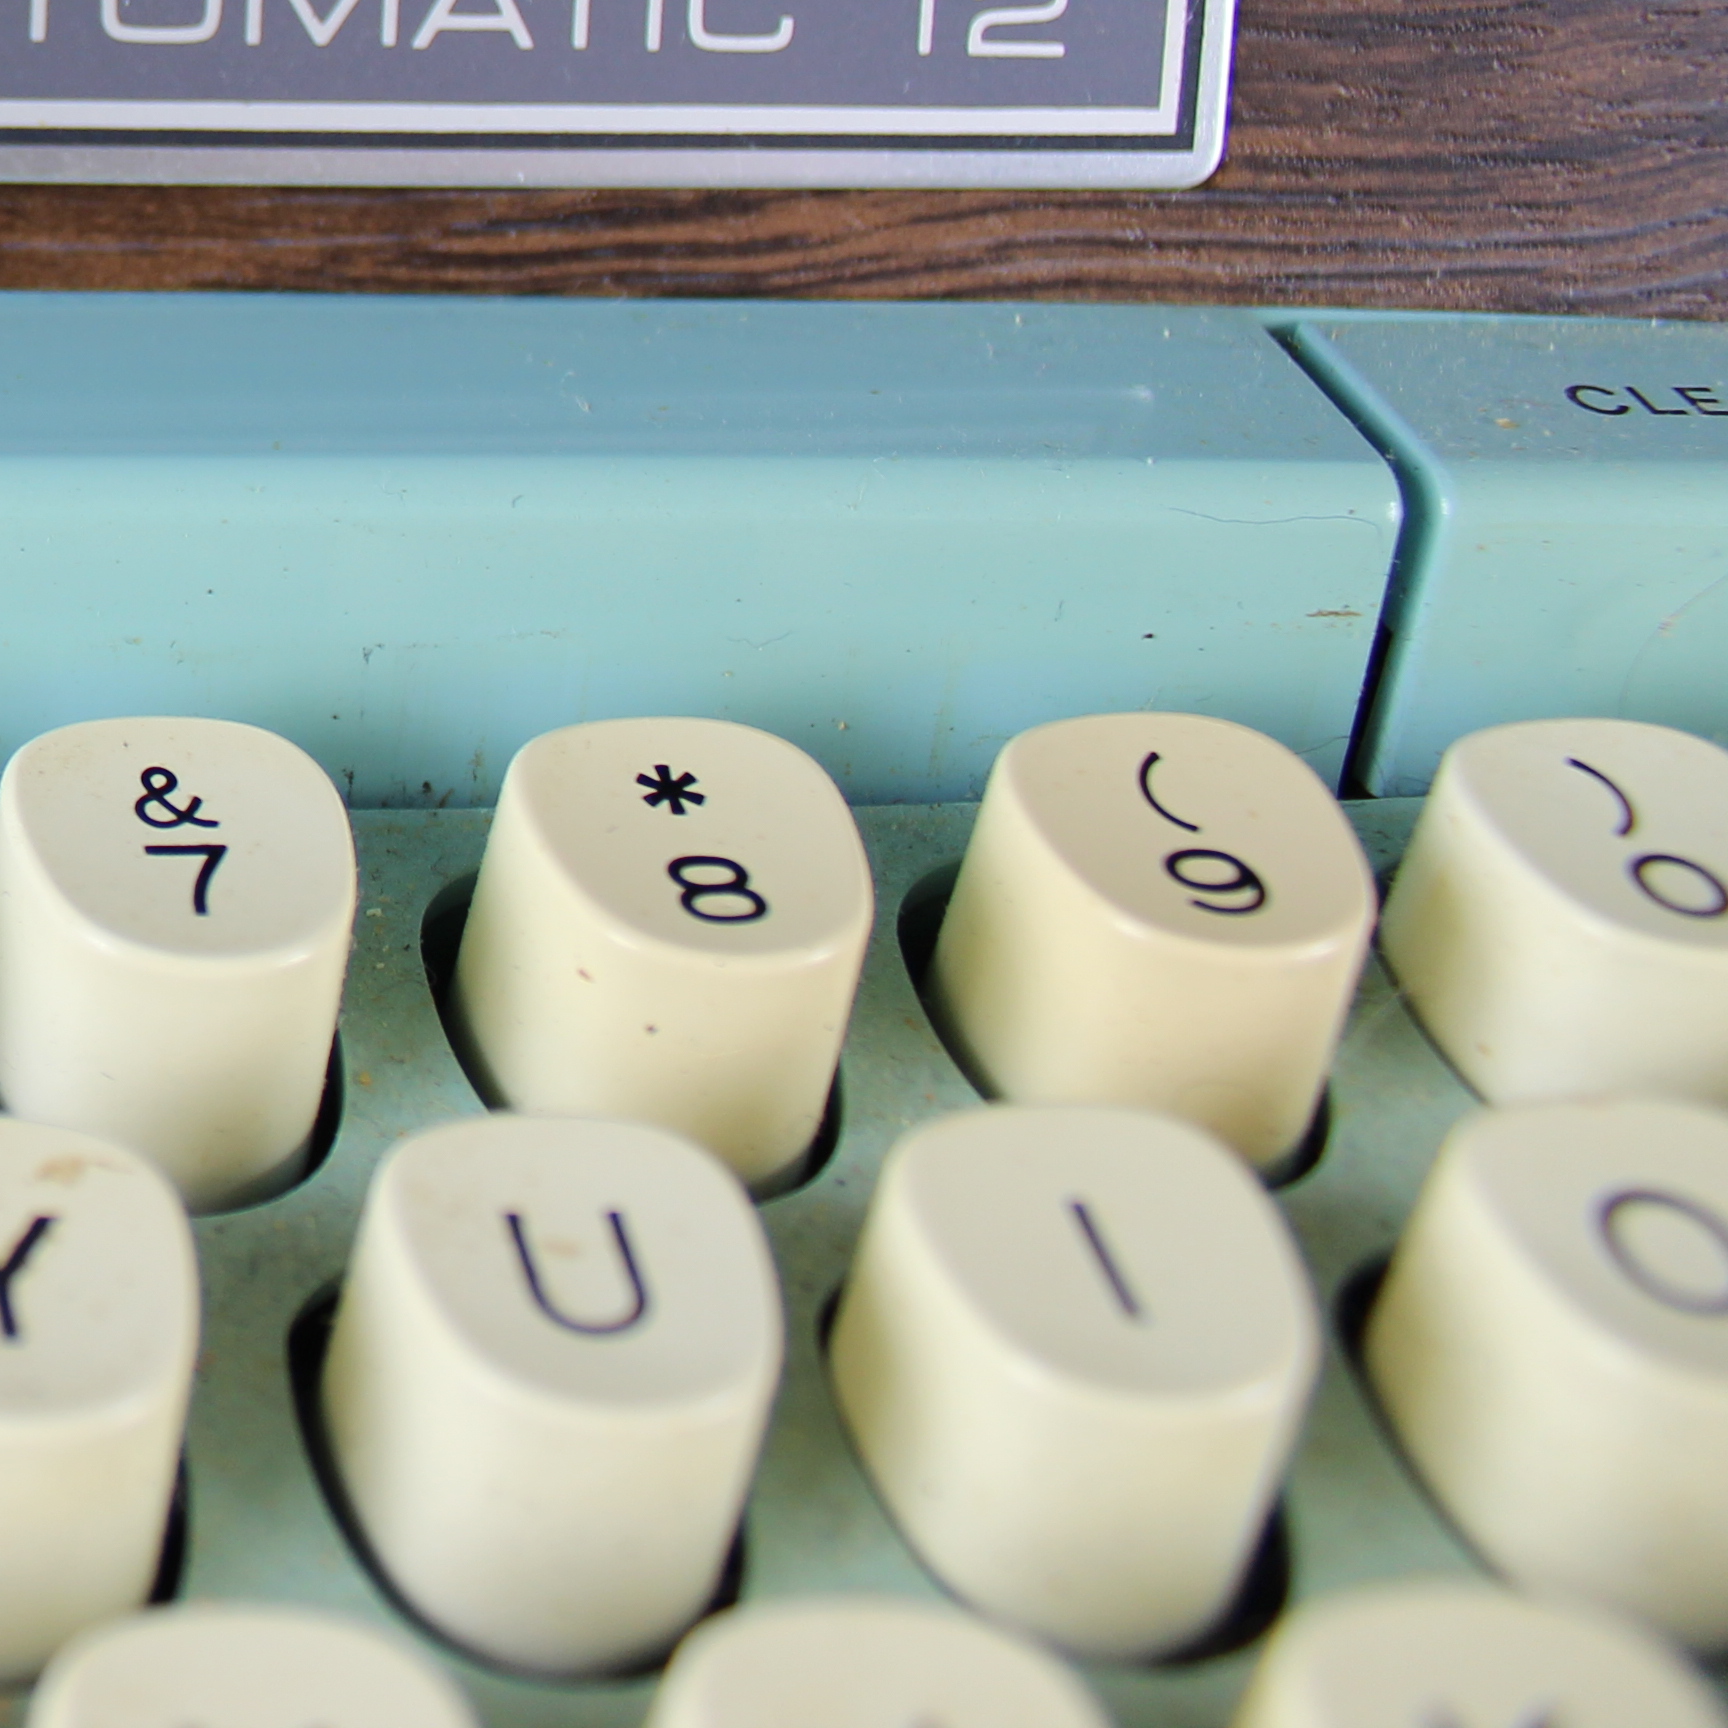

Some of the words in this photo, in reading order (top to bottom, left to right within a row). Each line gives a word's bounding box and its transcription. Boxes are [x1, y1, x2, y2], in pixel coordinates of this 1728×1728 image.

[133, 765, 221, 830] &
[143, 843, 229, 917] 7
[666, 854, 769, 925] 8
[1163, 847, 1268, 916] 9
[502, 1209, 652, 1339] U
[1066, 1197, 1144, 1322] I
